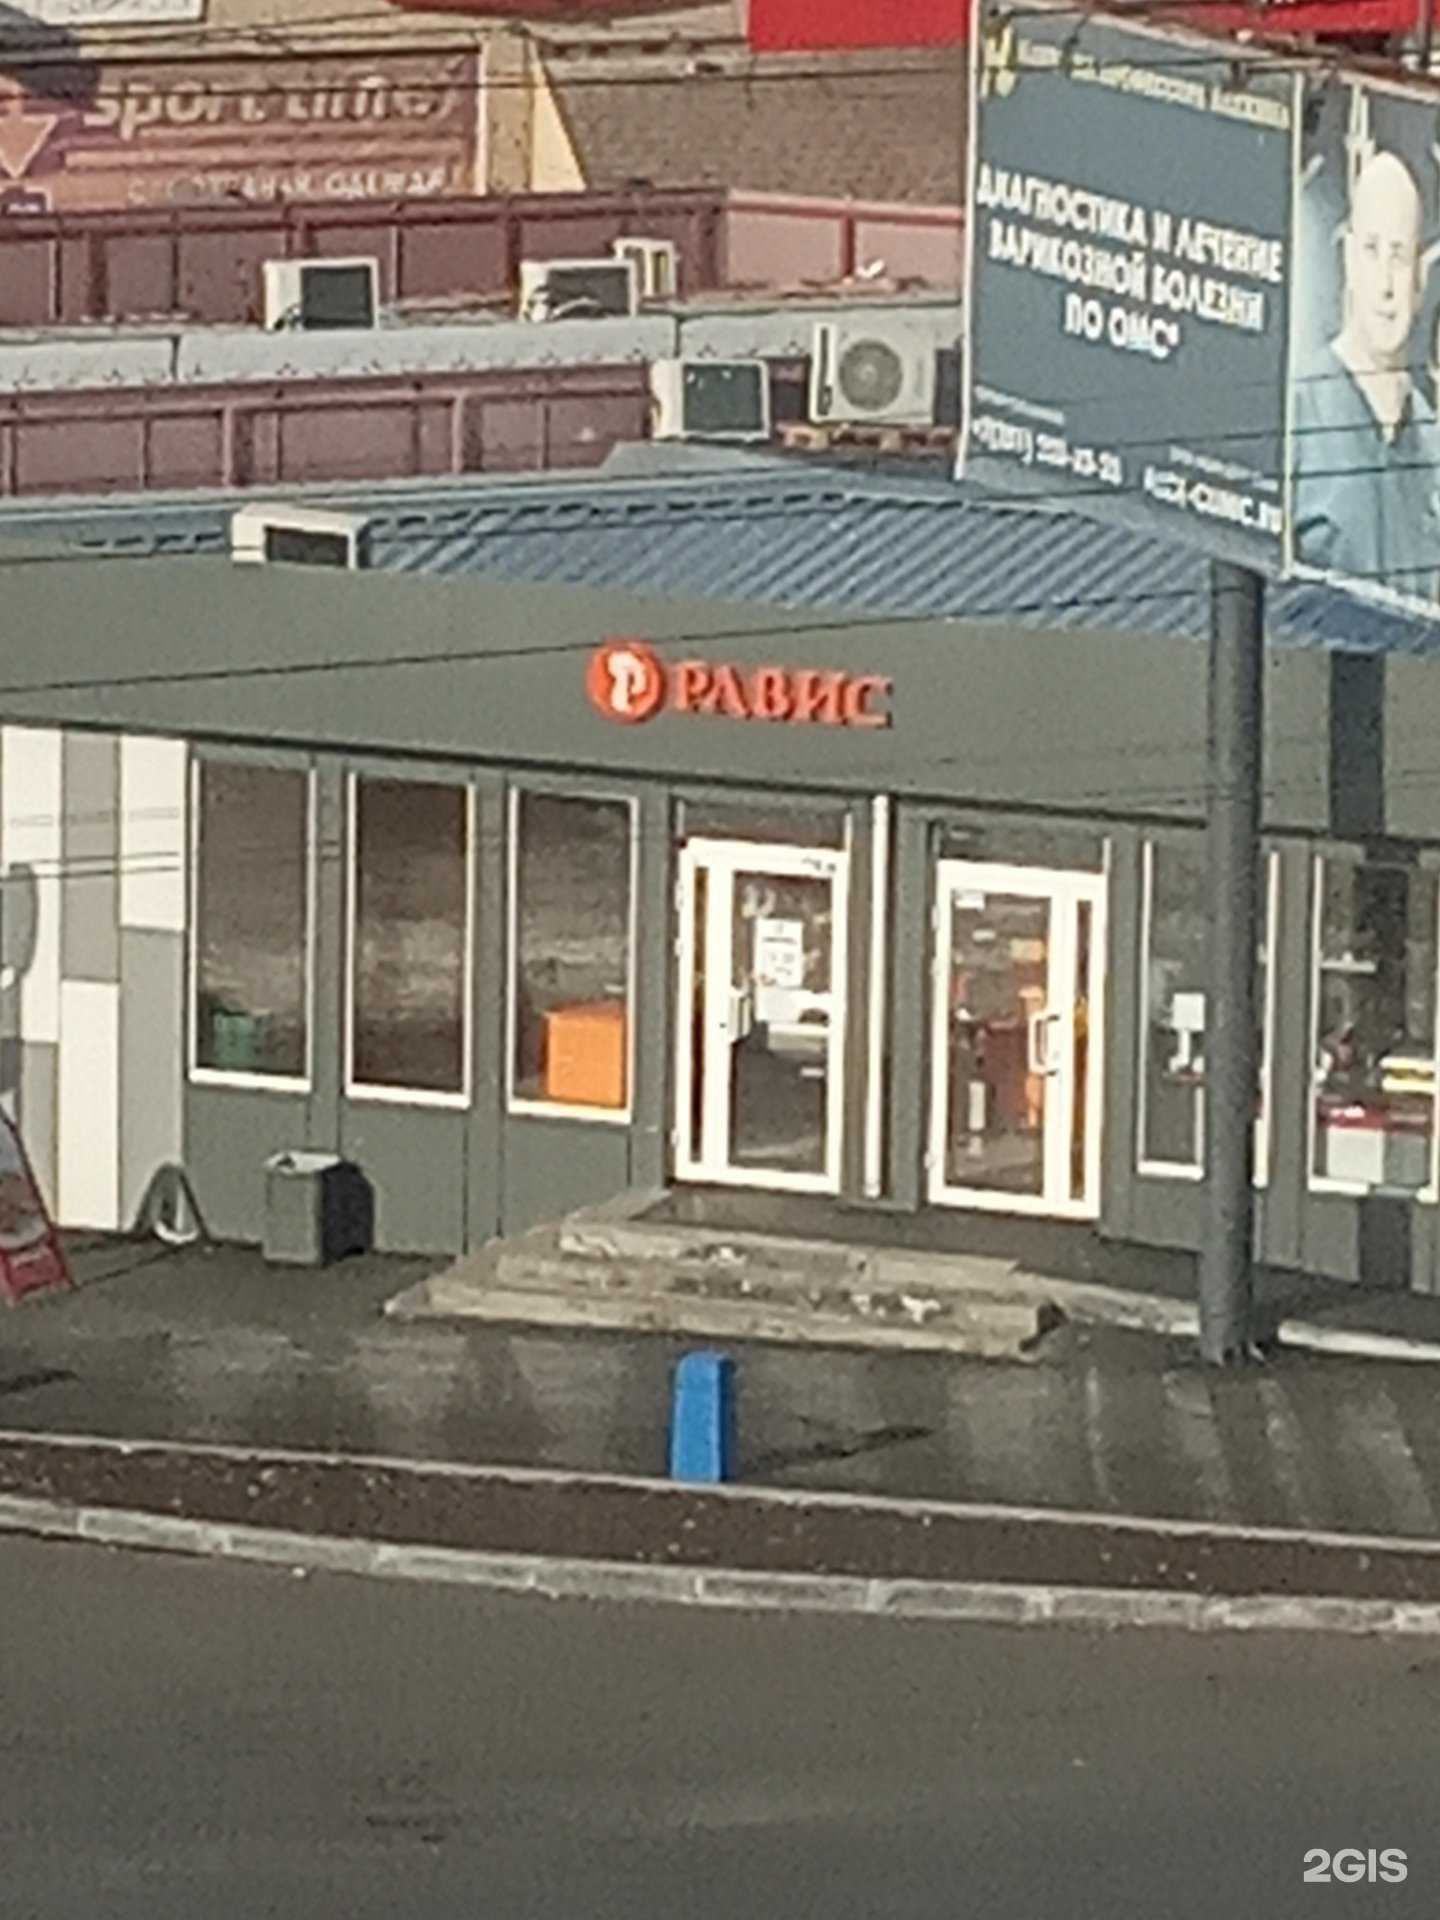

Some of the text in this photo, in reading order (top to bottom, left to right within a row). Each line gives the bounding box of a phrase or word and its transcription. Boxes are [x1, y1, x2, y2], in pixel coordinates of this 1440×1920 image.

[988, 218, 1265, 332] ВАРИКОЗНОЙ БОЛЕЗНИ
[1154, 210, 1172, 252] И
[1175, 217, 1283, 283] ЛЕЧЕНИЕ
[1064, 292, 1103, 340] ПО
[673, 659, 894, 729] РАВИС
